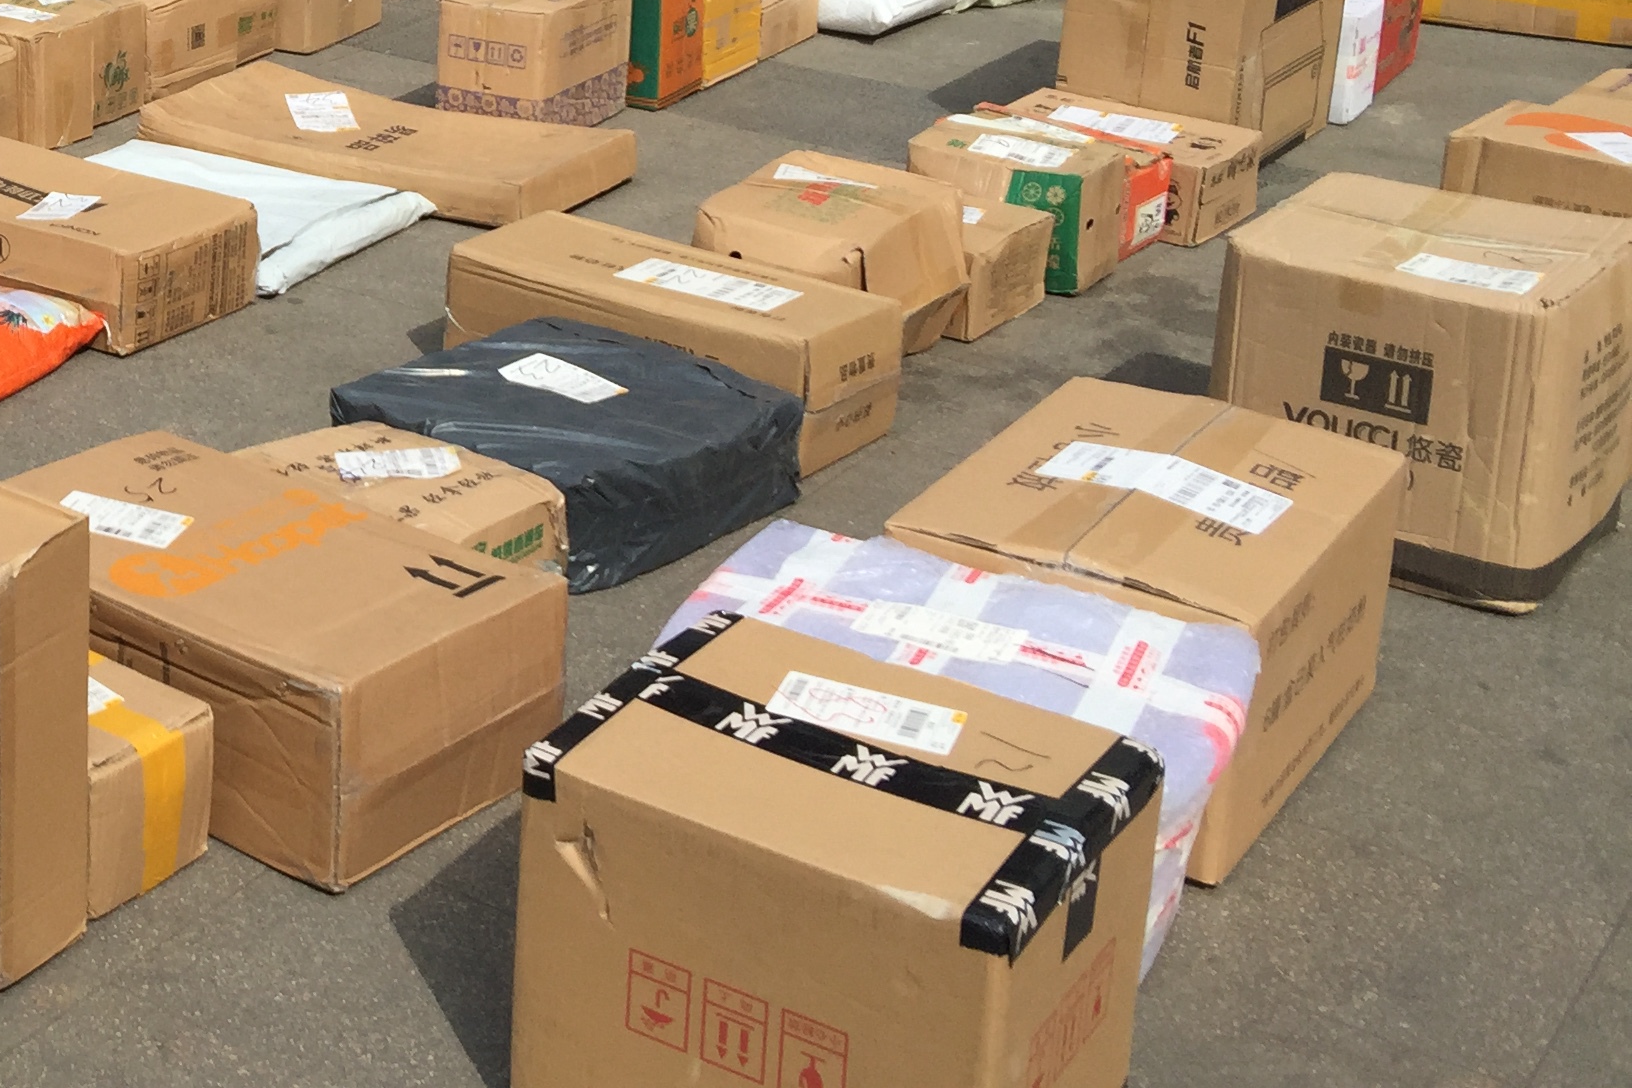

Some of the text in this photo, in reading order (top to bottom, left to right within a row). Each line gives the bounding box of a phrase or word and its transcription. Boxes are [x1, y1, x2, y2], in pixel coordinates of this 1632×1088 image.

[1185, 21, 1207, 90] 启航者F1
[1327, 330, 1377, 355] 内装瓷器
[1383, 342, 1434, 368] 请勿挤压
[1406, 433, 1464, 472] 悠瓷
[124, 476, 178, 504] 25
[715, 701, 794, 744] WMF
[831, 744, 909, 787] WMF
[957, 780, 1036, 825] WMF
